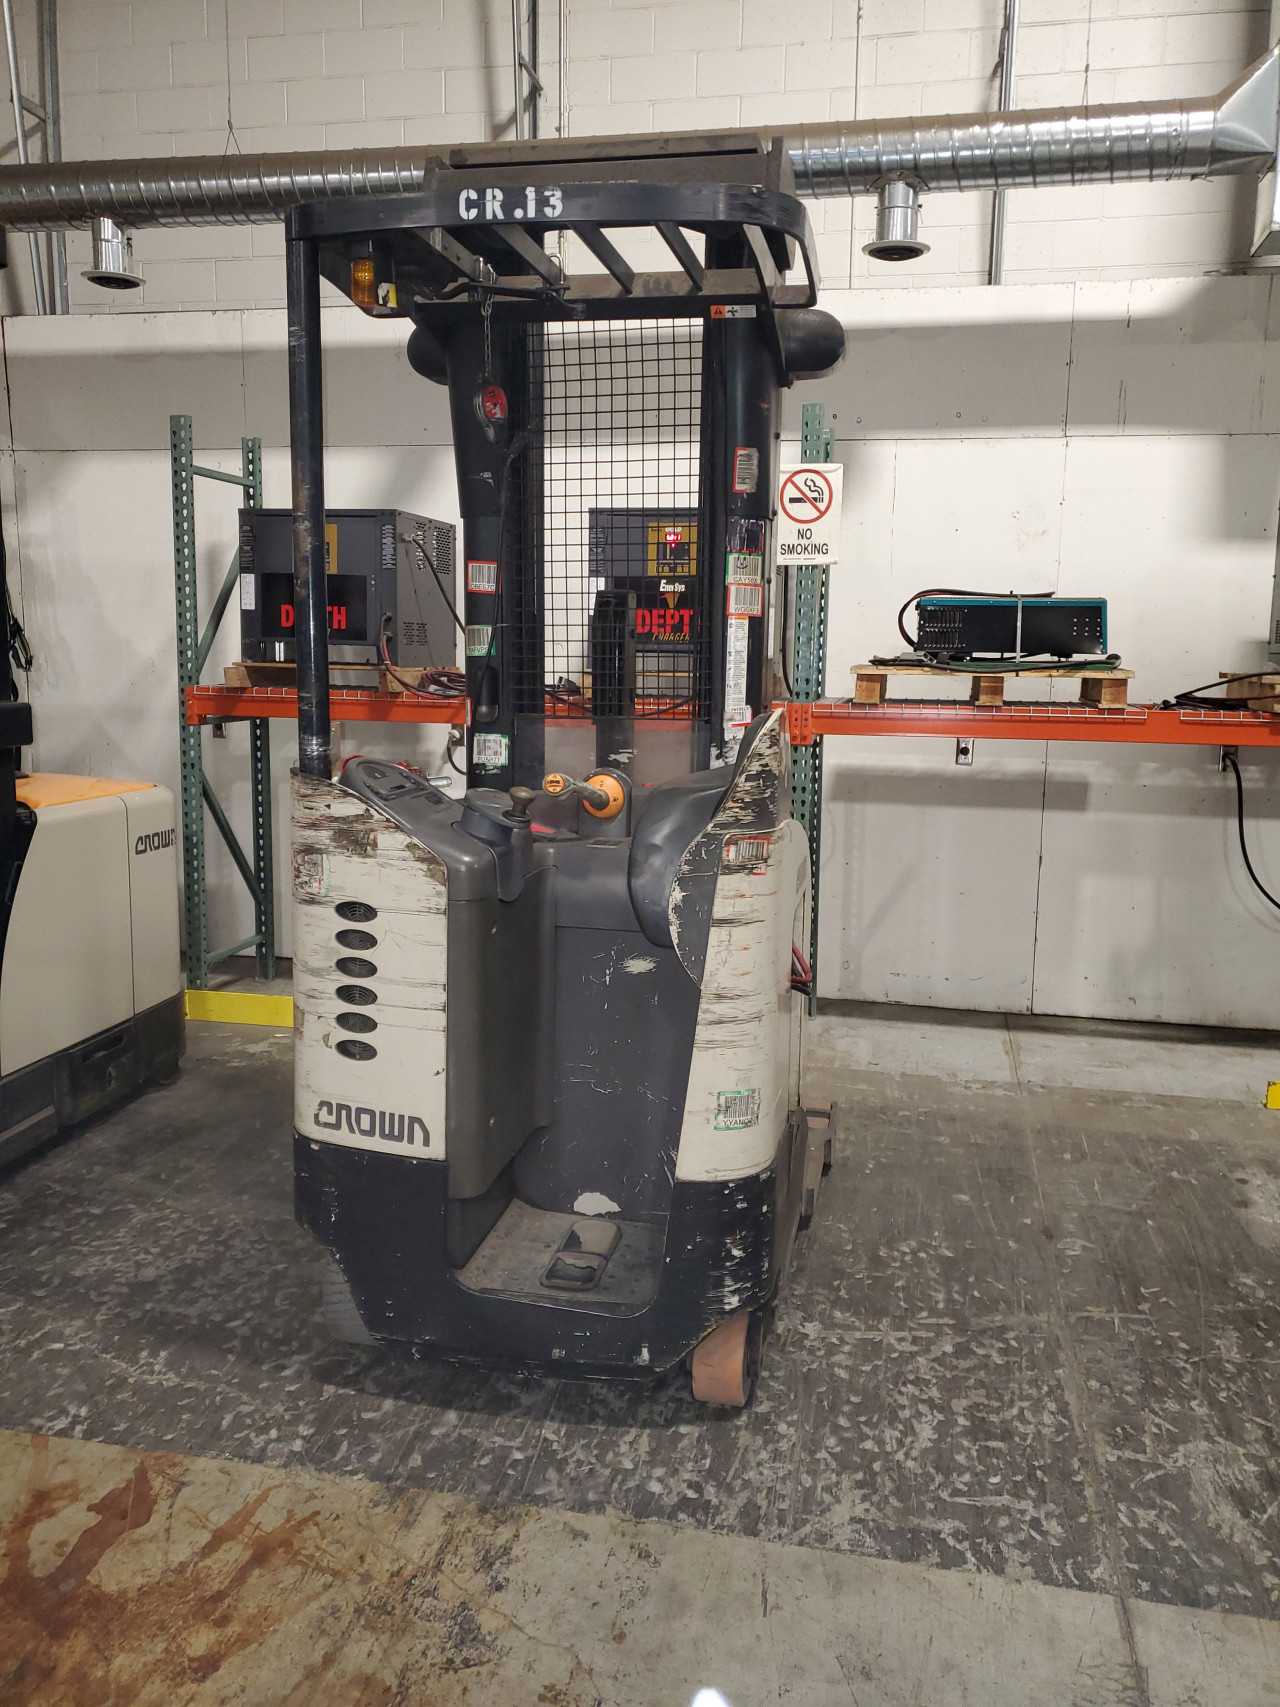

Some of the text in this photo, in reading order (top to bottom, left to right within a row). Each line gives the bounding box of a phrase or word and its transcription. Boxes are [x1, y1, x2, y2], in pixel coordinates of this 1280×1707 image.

[458, 185, 564, 221] CR.13
[797, 528, 813, 540] NO
[780, 543, 829, 555] SMOKING
[635, 607, 699, 634] DEPT
[313, 1099, 431, 1148] CROWN
